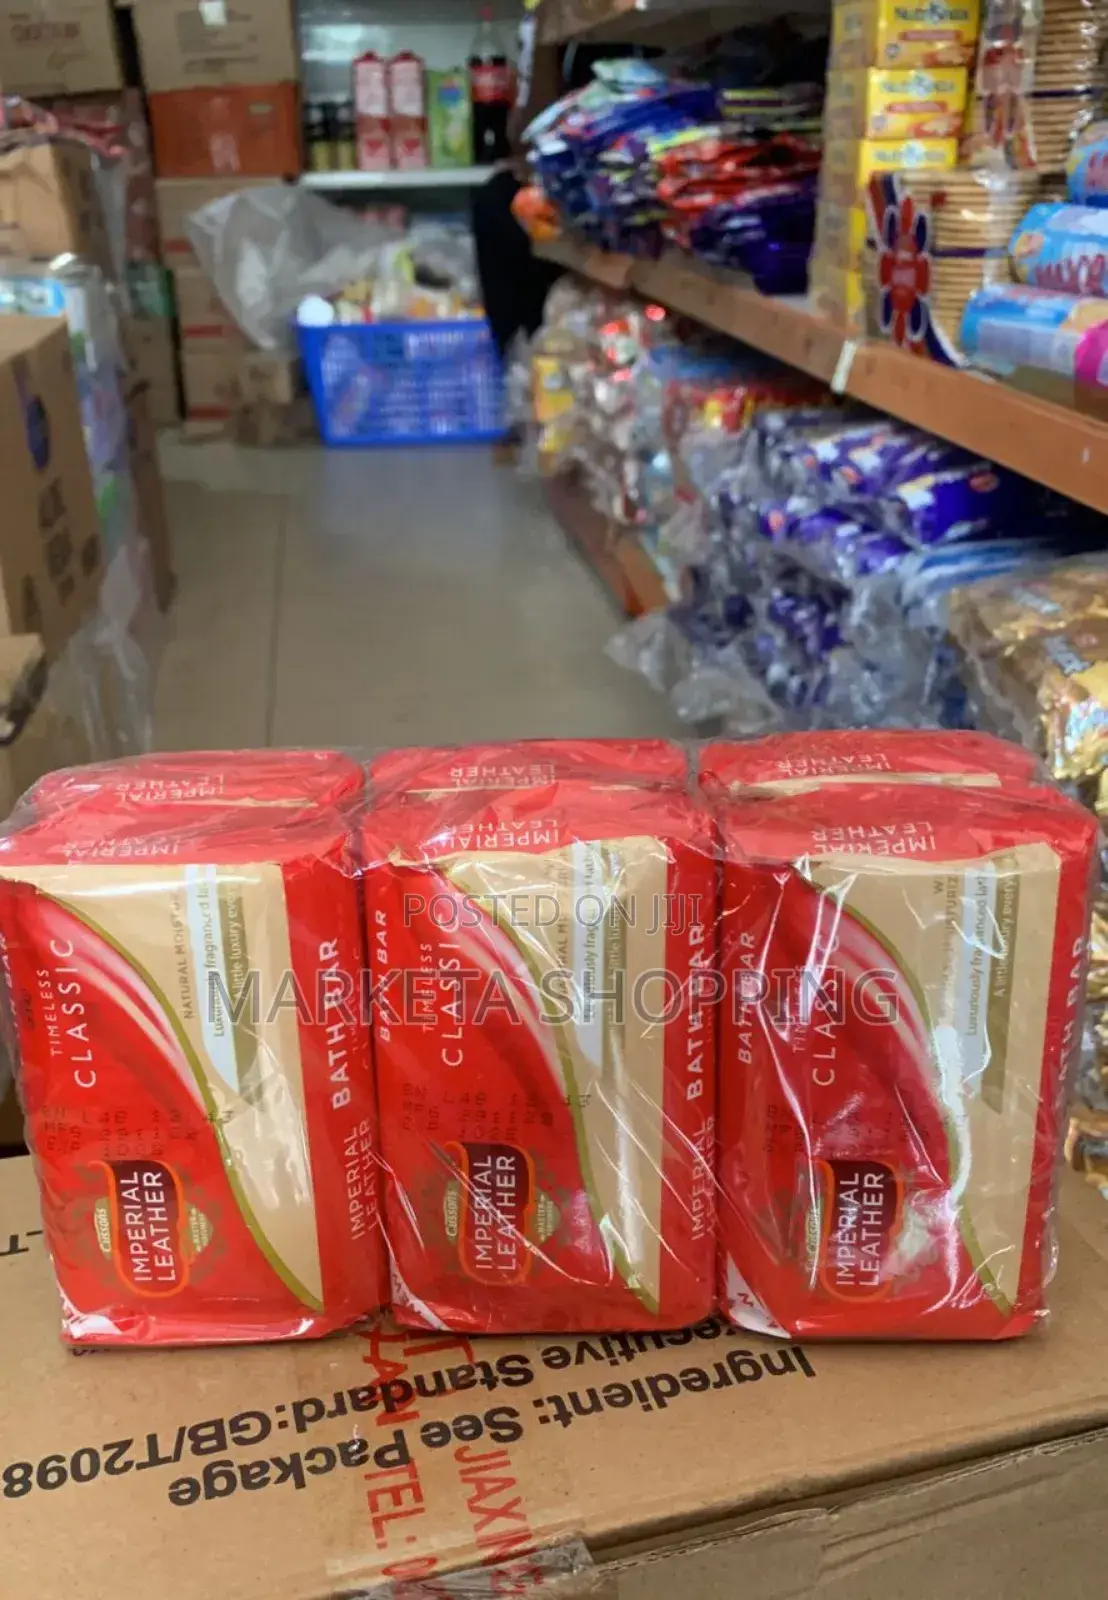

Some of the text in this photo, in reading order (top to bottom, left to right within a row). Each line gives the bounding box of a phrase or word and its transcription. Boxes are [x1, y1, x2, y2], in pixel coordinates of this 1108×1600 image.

[811, 821, 933, 841] LEATHER
[814, 834, 936, 854] IMPERIAL
[227, 920, 242, 960] luxury
[318, 937, 342, 1010] BAR
[374, 909, 389, 965] BAR
[37, 969, 63, 1057] TIMELESS
[50, 939, 97, 1089] CLASSIC
[175, 959, 195, 1020] NATURAL
[439, 914, 464, 1067] CLASSIC
[737, 1001, 753, 1064] BATH
[325, 1022, 351, 1109] BATH
[686, 1013, 705, 1101] BATH
[120, 1171, 153, 1282] IMPERIAL
[143, 1171, 176, 1282] LEATHER
[343, 1127, 366, 1240] IMPERIAL
[473, 1154, 494, 1270] IMPERIAL
[495, 1155, 517, 1271] LEATHER
[95, 1207, 112, 1254] Cussons
[836, 1172, 860, 1286] IMPERIAL
[859, 1172, 886, 1287] LEATHER
[420, 1406, 524, 1449] See
[533, 1346, 817, 1428] Ingredient:
[168, 1429, 412, 1506] Package
